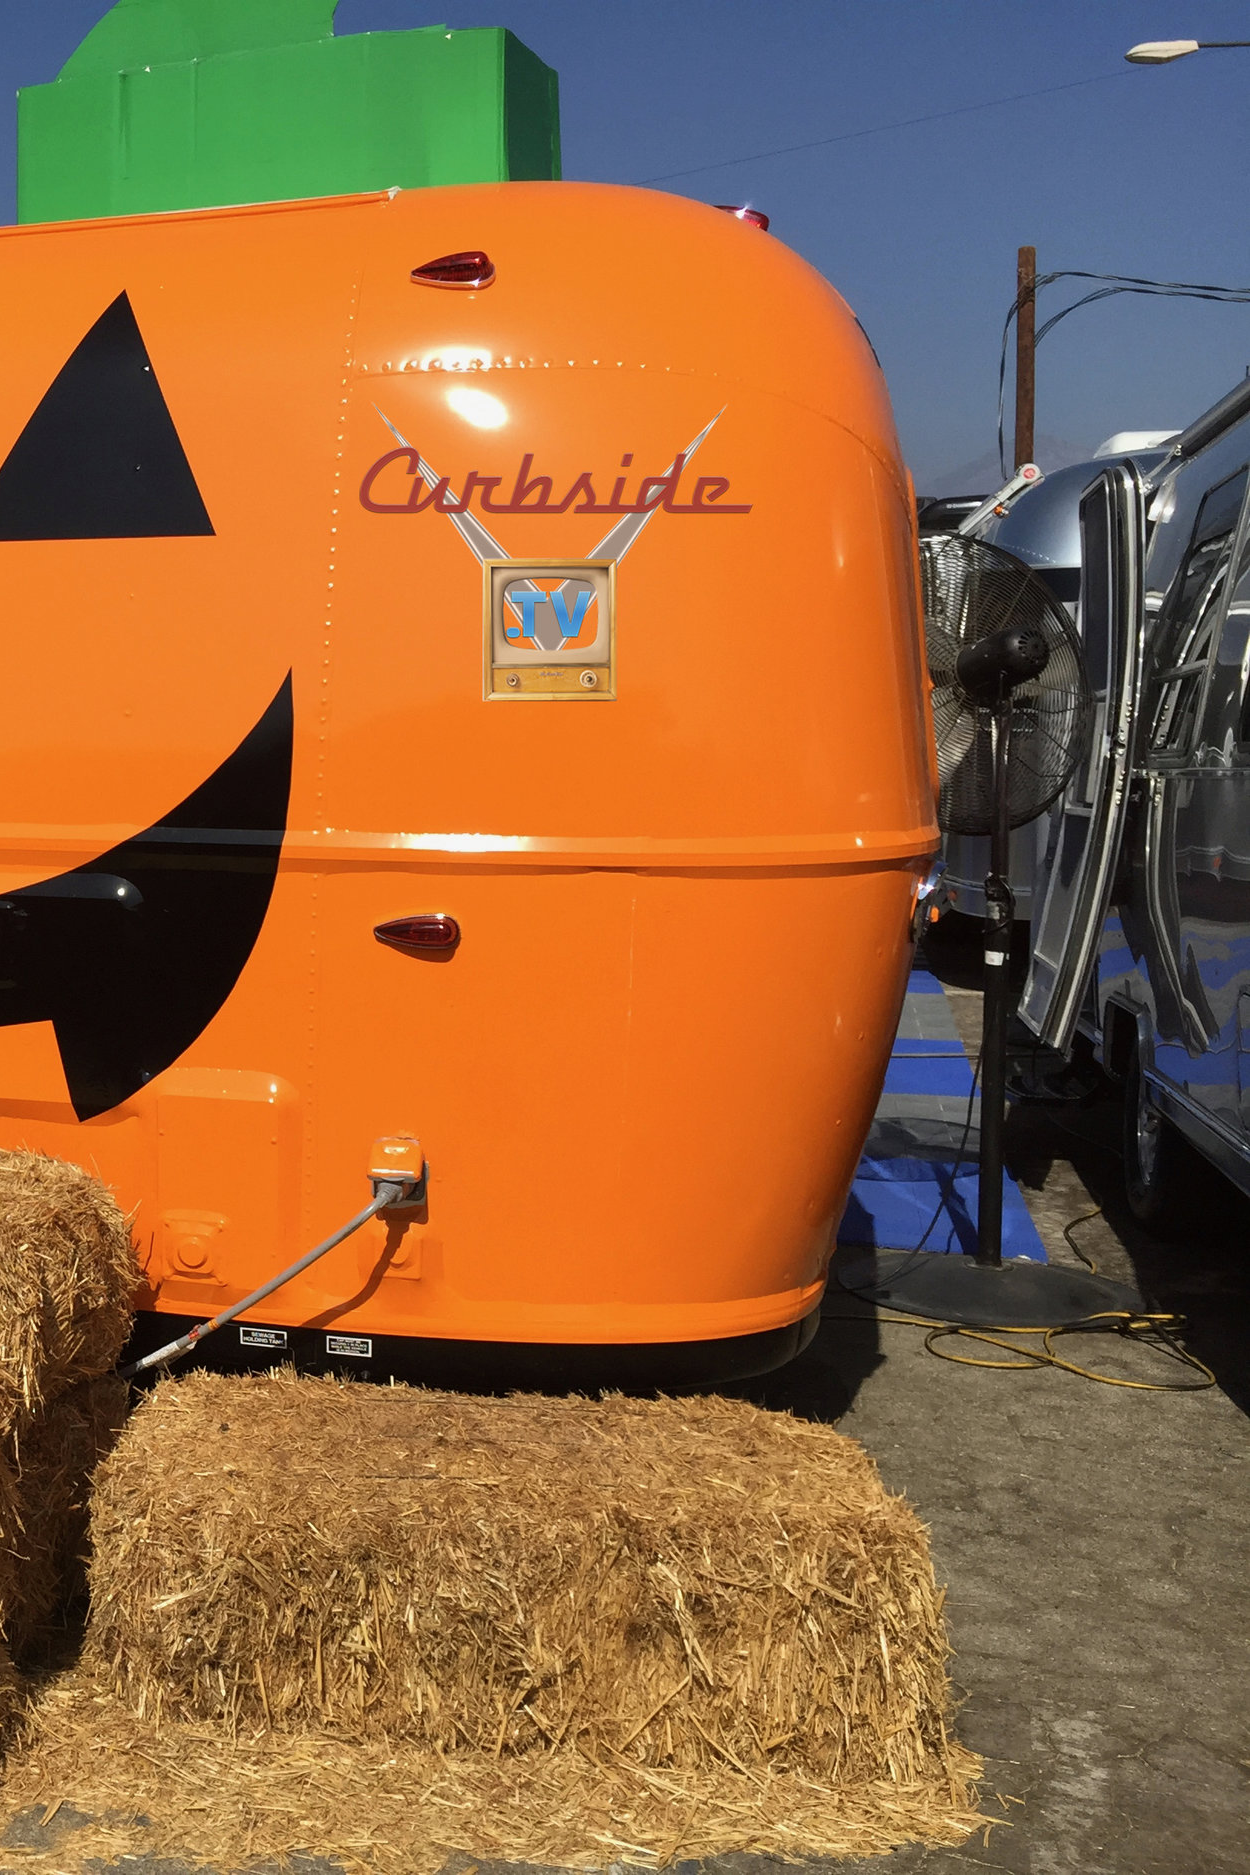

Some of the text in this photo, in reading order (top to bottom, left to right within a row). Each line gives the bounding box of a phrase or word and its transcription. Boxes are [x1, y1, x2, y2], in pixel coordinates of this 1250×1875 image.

[359, 447, 753, 514] Curbside
[251, 1331, 276, 1339] SEWAGE
[243, 1336, 269, 1344] HOLDING
